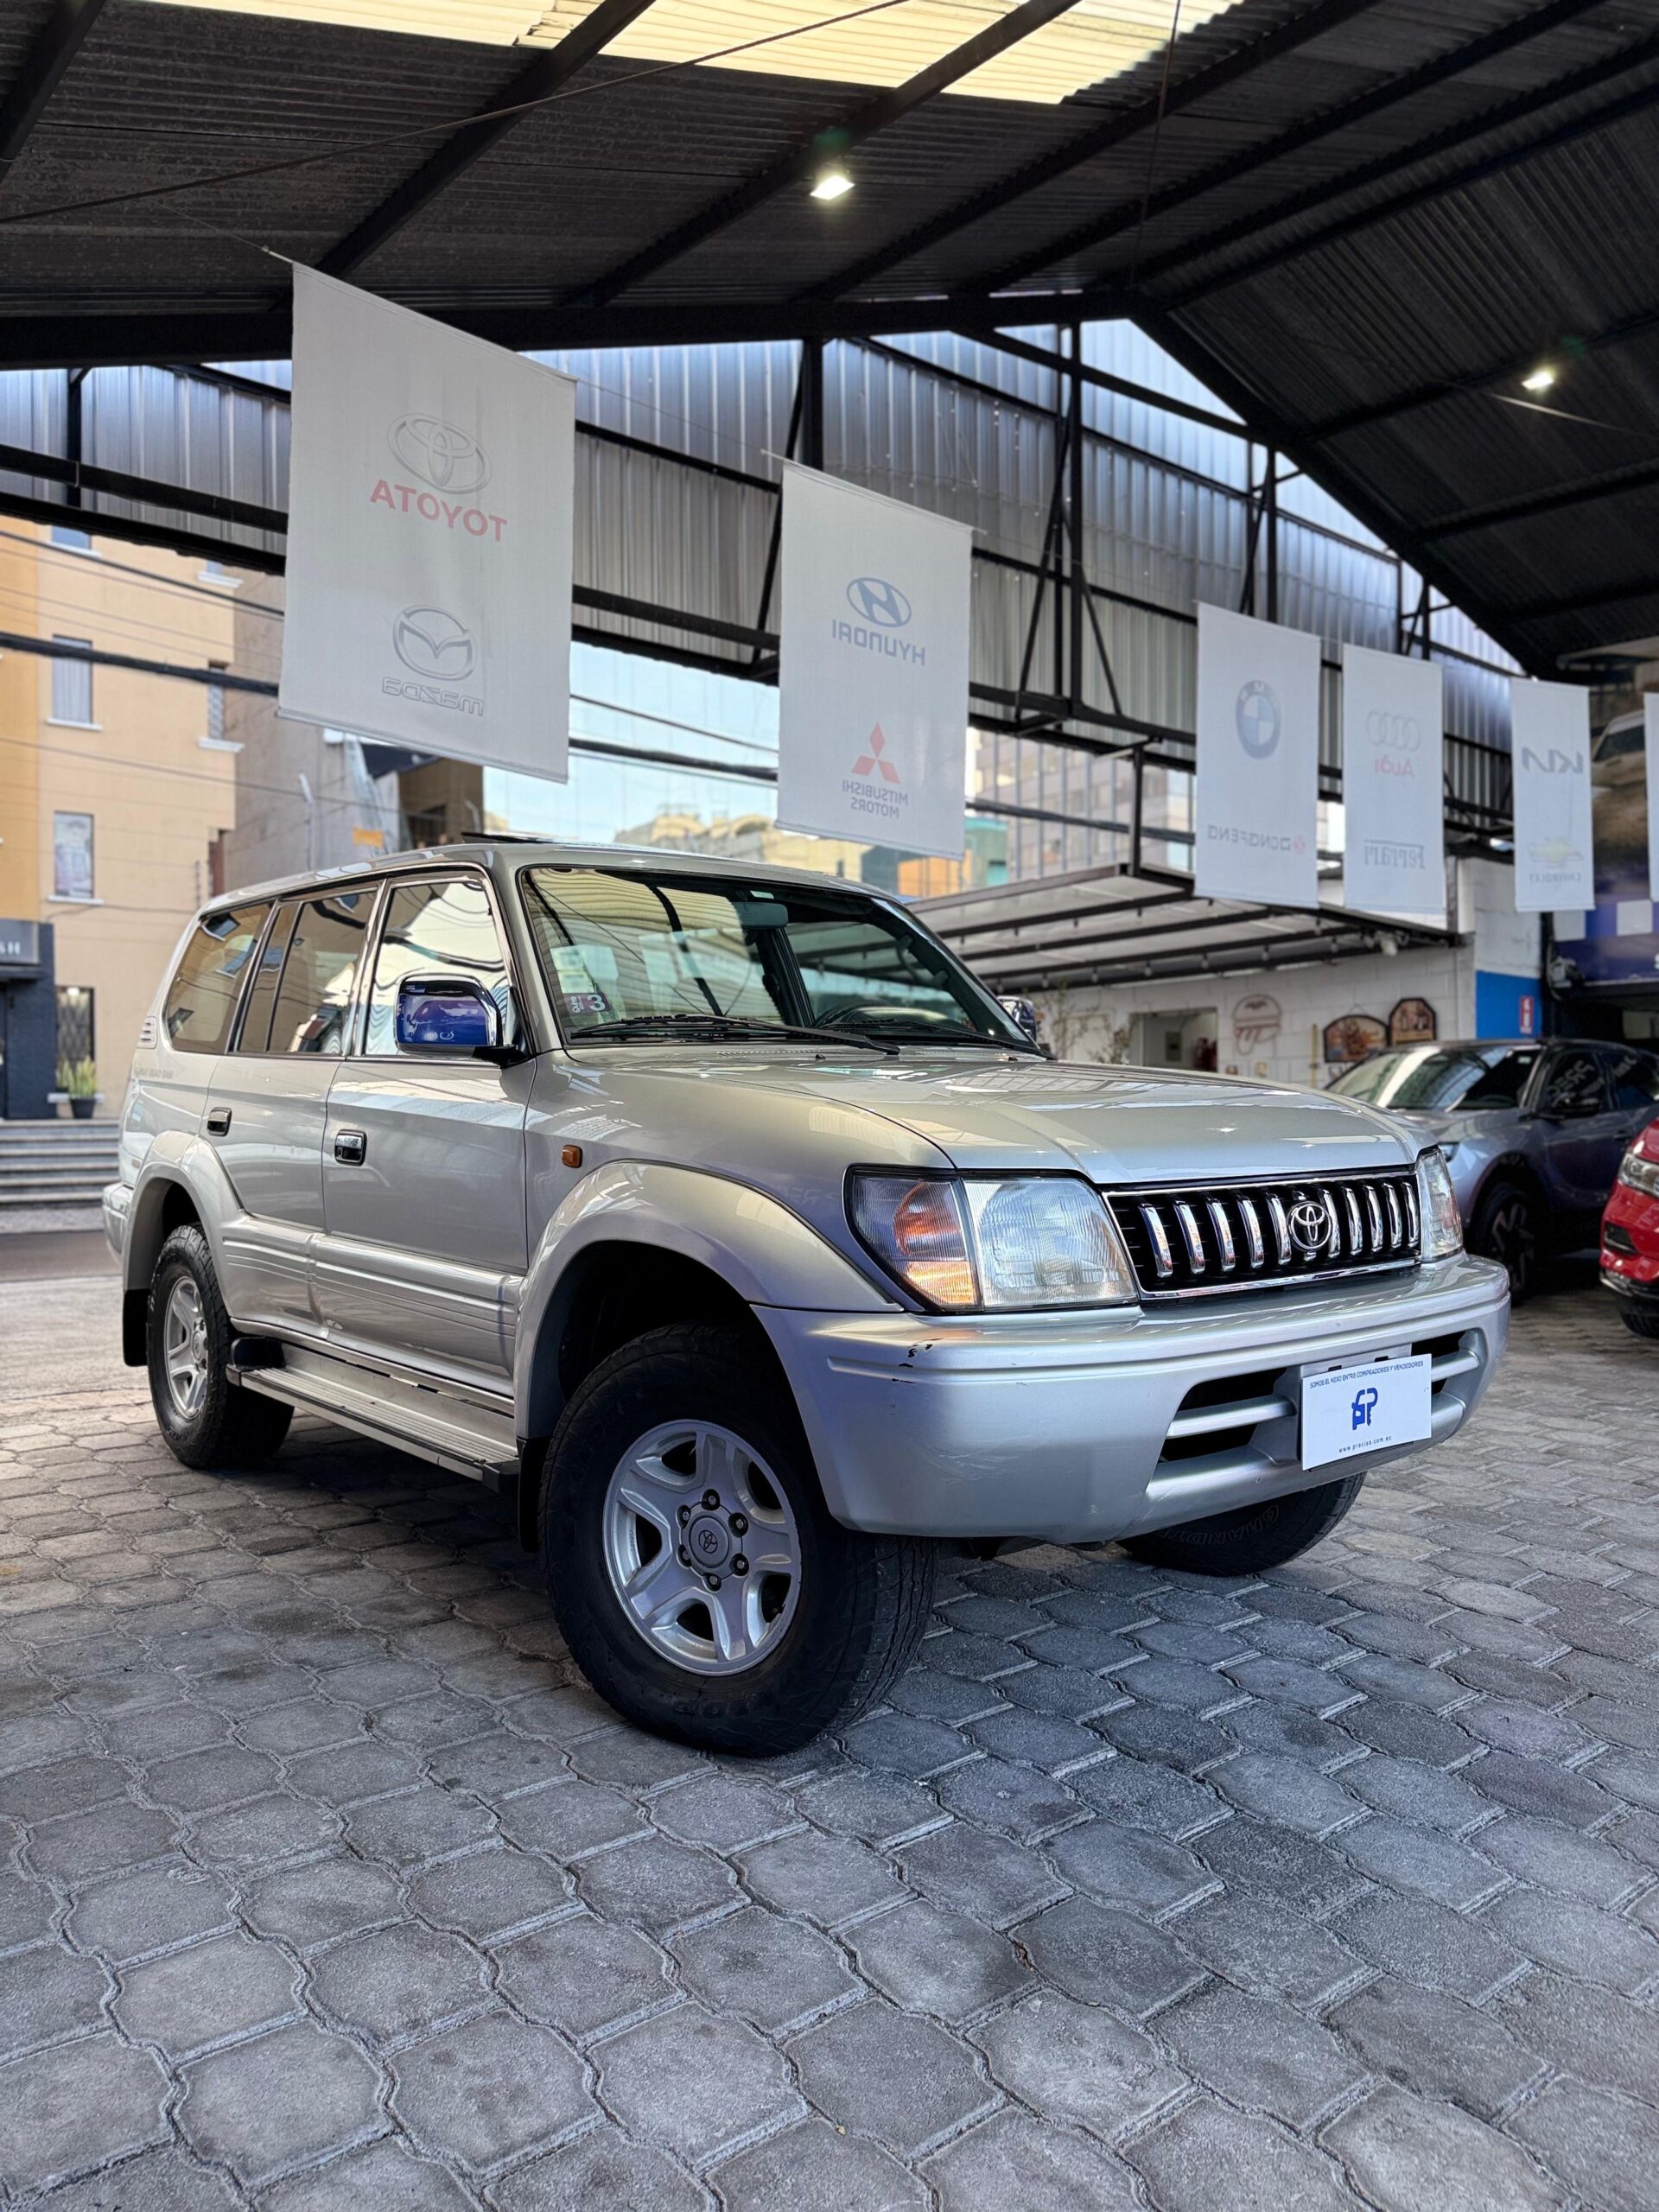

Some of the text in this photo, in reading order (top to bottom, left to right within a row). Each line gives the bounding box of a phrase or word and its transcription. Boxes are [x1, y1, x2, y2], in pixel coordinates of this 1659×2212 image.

[587, 994, 606, 1012] 3
[1343, 1372, 1357, 1382] ENTRE
[1357, 1366, 1390, 1378] COMPRADORES
[1393, 1360, 1424, 1371] VENDEDORES
